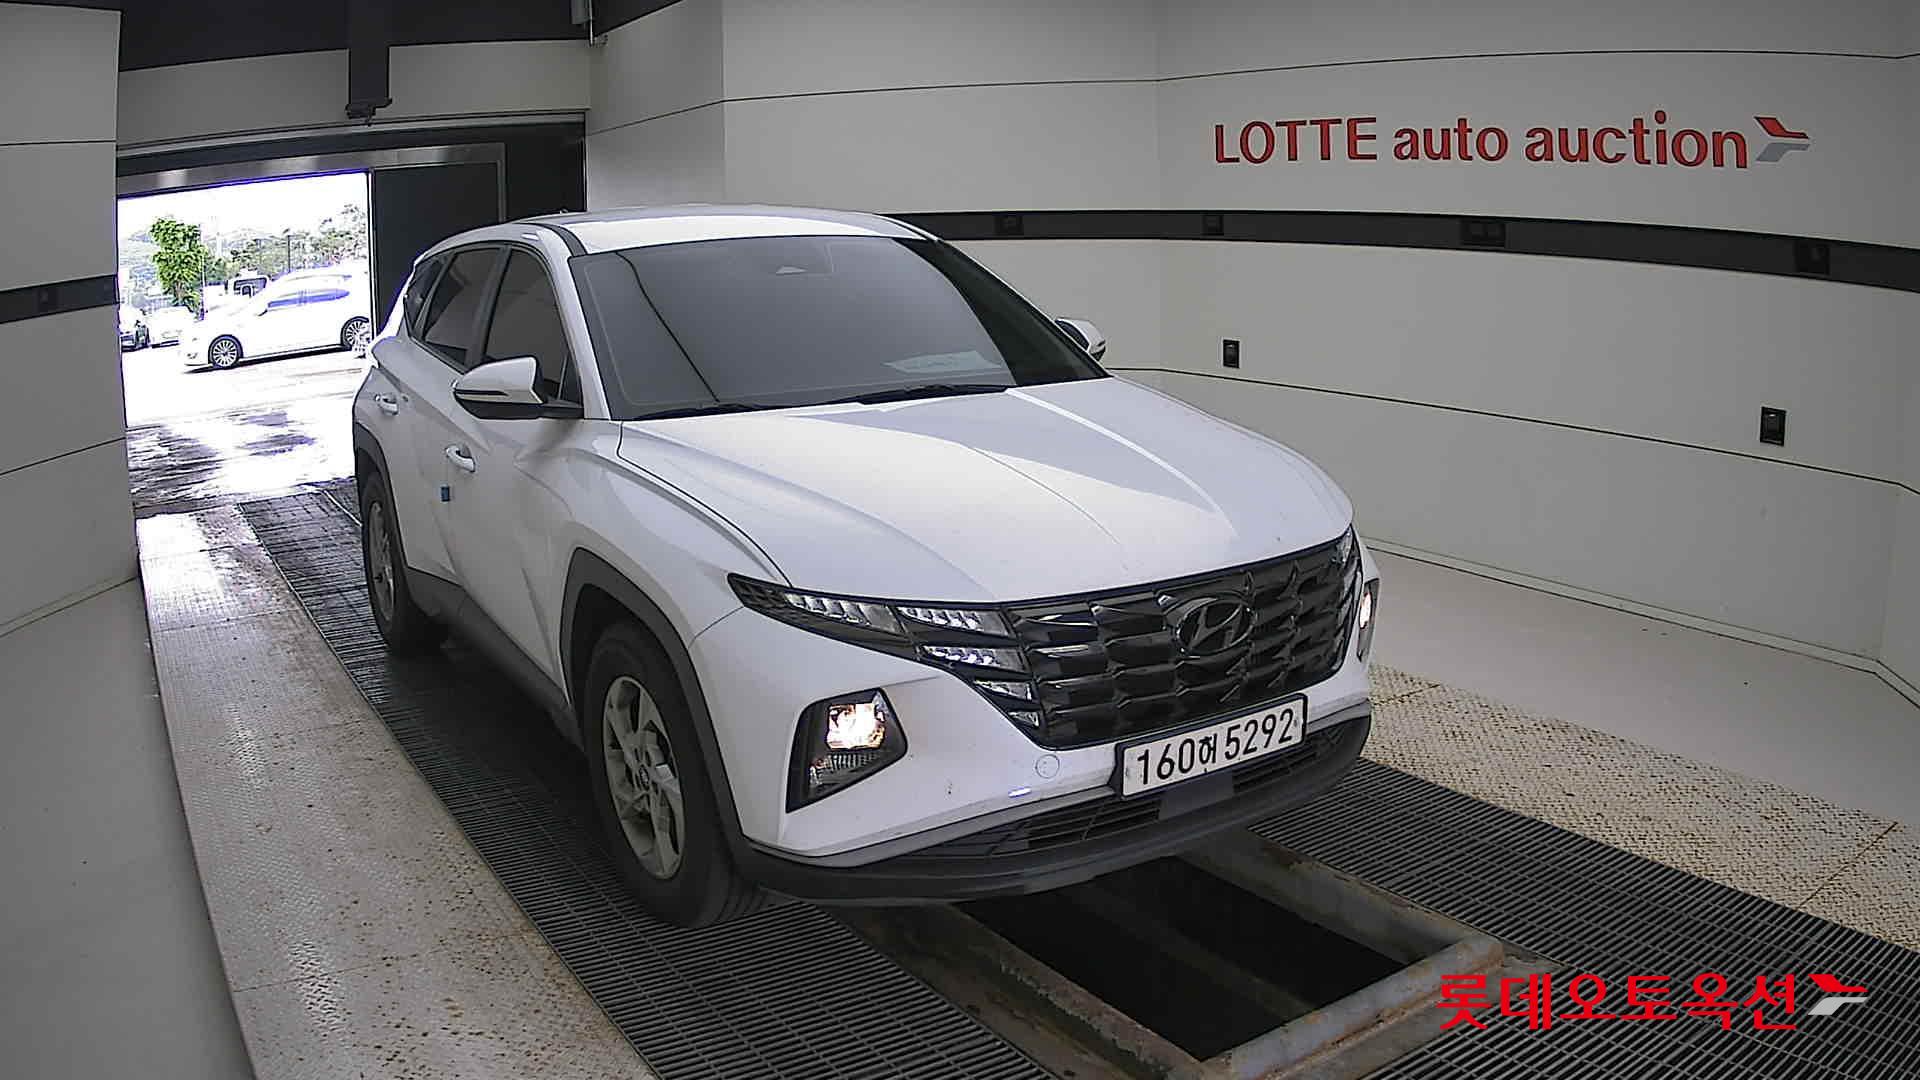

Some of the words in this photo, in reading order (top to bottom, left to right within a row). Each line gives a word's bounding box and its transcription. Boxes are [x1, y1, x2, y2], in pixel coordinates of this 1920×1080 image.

[1215, 118, 1377, 165] LOTTE
[1393, 118, 1509, 162] auto
[1524, 110, 1748, 168] auction
[1136, 733, 1218, 785] 160허
[1224, 708, 1294, 760] 5292
